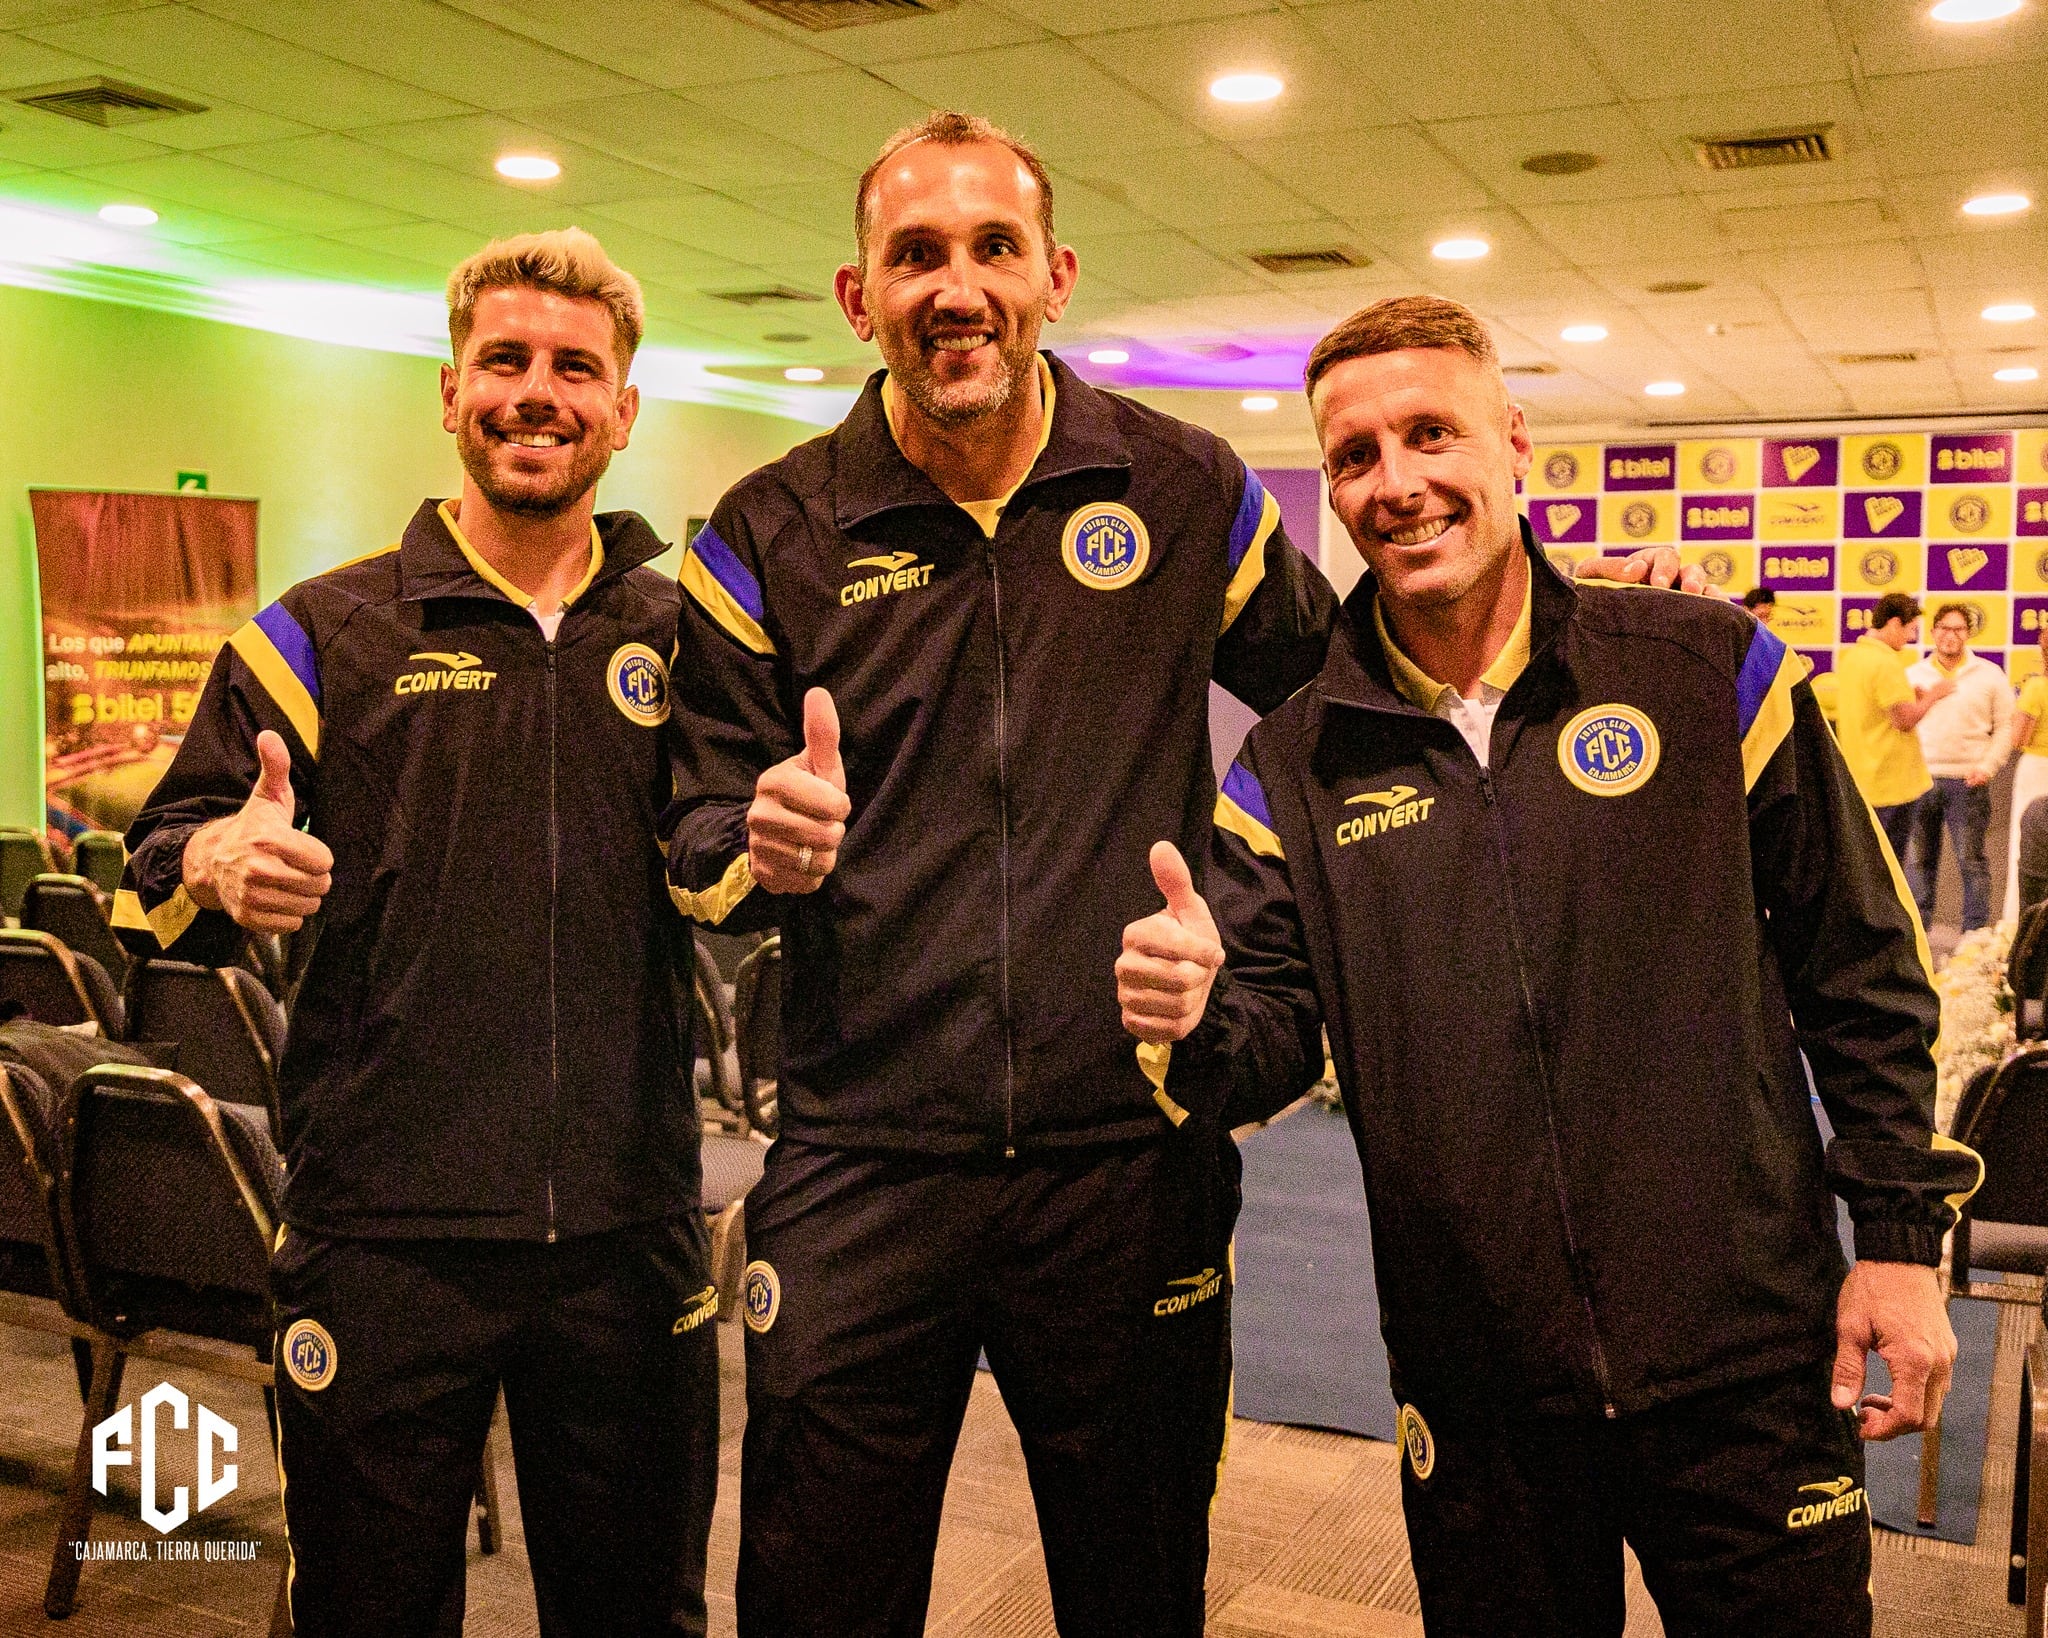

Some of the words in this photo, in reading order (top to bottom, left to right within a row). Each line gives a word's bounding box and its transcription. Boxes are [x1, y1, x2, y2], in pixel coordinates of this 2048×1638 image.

[1111, 519, 1129, 534] CLUB
[1087, 526, 1126, 566] FCC
[1084, 560, 1129, 576] CAJAMARCA
[841, 564, 934, 607] CONVERT
[49, 633, 86, 653] Los
[88, 636, 125, 655] que
[46, 661, 89, 682] alto,
[94, 660, 213, 681] TRIUNFAMOS
[394, 670, 497, 695] CONVERT
[627, 667, 658, 704] FCC
[96, 692, 163, 724] bitel
[1609, 720, 1631, 732] CLUB
[1586, 728, 1632, 770] FCC
[1588, 760, 1638, 781] CAJAMARCA
[1336, 797, 1435, 847] CONVERT
[1153, 1273, 1223, 1317] CONVERT
[672, 1292, 719, 1335] CONVERT
[297, 1341, 321, 1371] FCC
[1787, 1487, 1863, 1529] CONVERT
